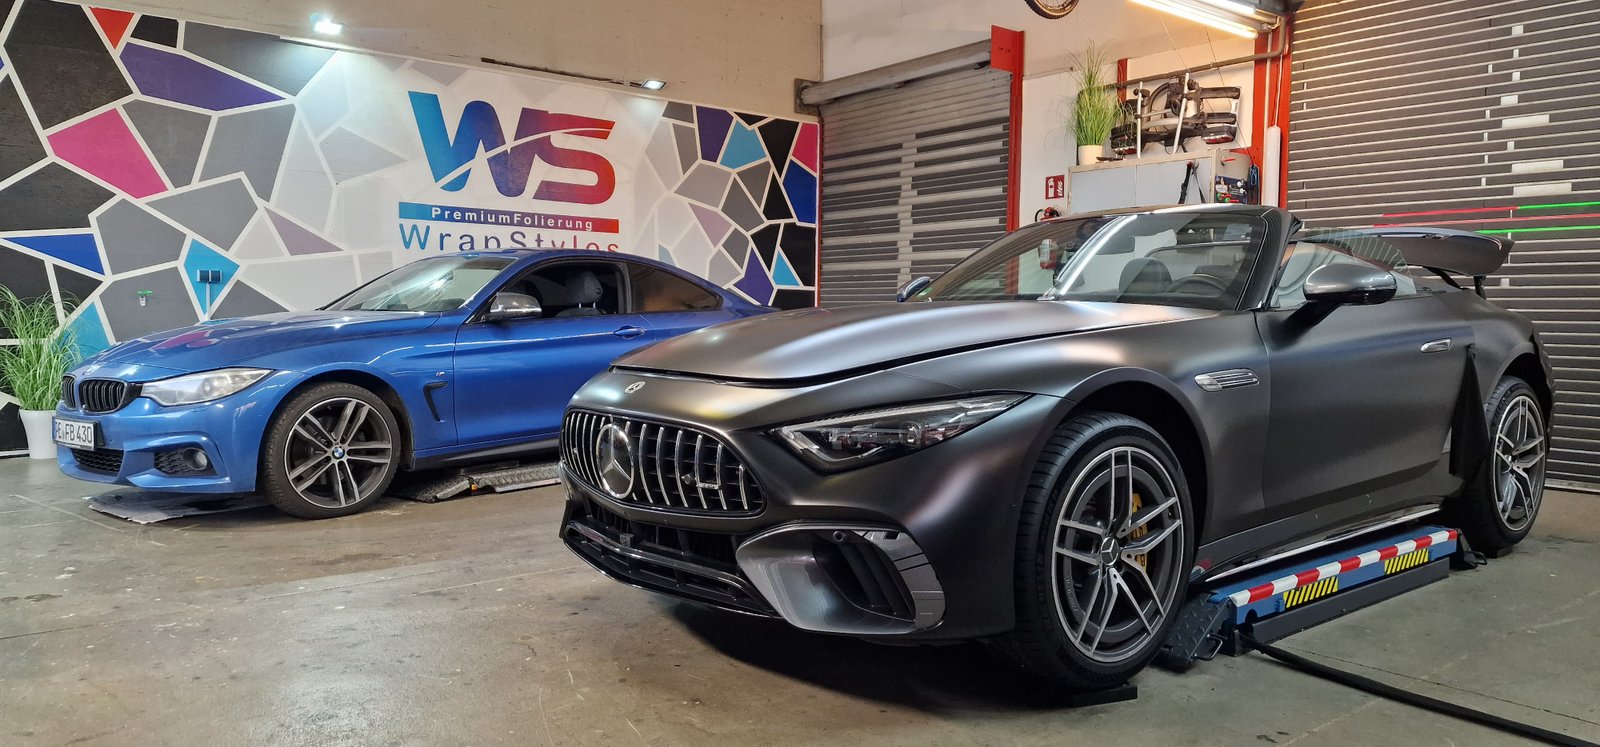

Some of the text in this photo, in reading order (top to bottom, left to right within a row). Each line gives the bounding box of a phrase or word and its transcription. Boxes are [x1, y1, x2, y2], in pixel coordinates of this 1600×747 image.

[408, 91, 616, 204] WS
[431, 207, 593, 232] PremiumFolierung
[65, 424, 75, 441] FB
[76, 425, 92, 443] 430
